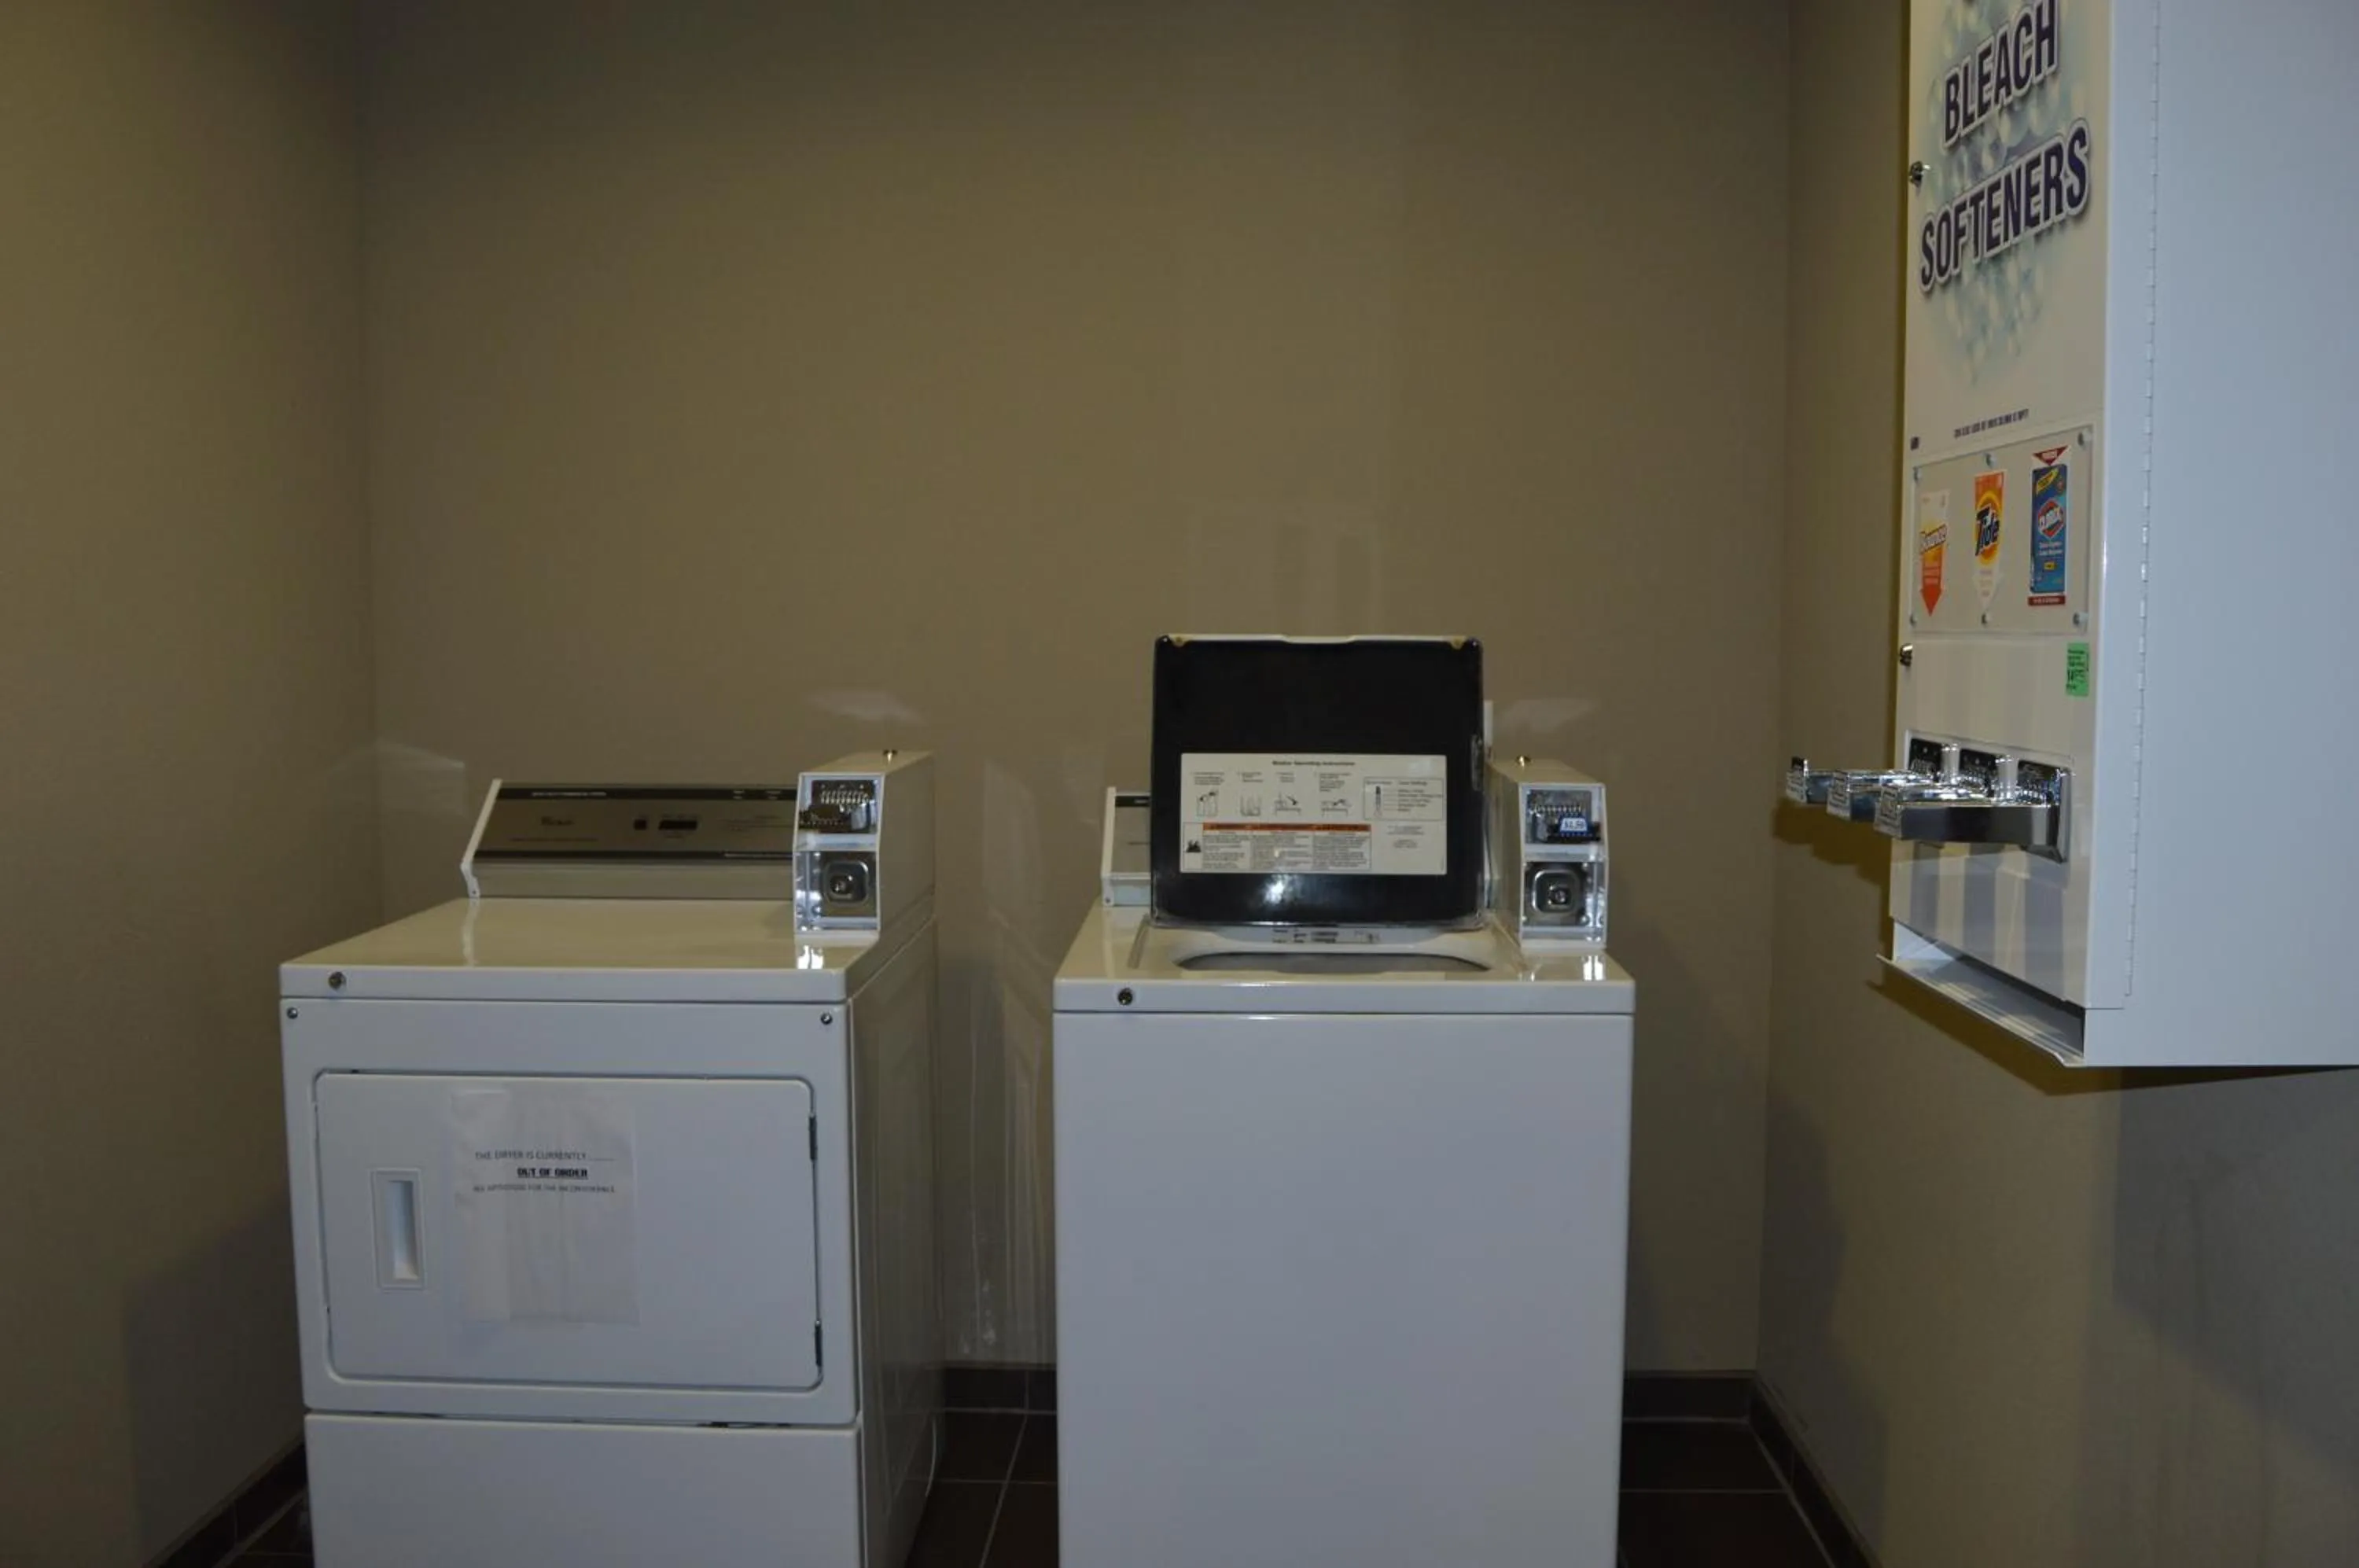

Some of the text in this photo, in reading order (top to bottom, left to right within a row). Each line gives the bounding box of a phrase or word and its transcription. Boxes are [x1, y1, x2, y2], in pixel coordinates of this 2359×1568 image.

[1944, 0, 2057, 145] BLEACH
[1920, 123, 2089, 289] SOFTENERS
[517, 1168, 588, 1179] OUT OF ORDER
[526, 1150, 535, 1160] IS
[535, 1150, 587, 1161] CURRENTLY
